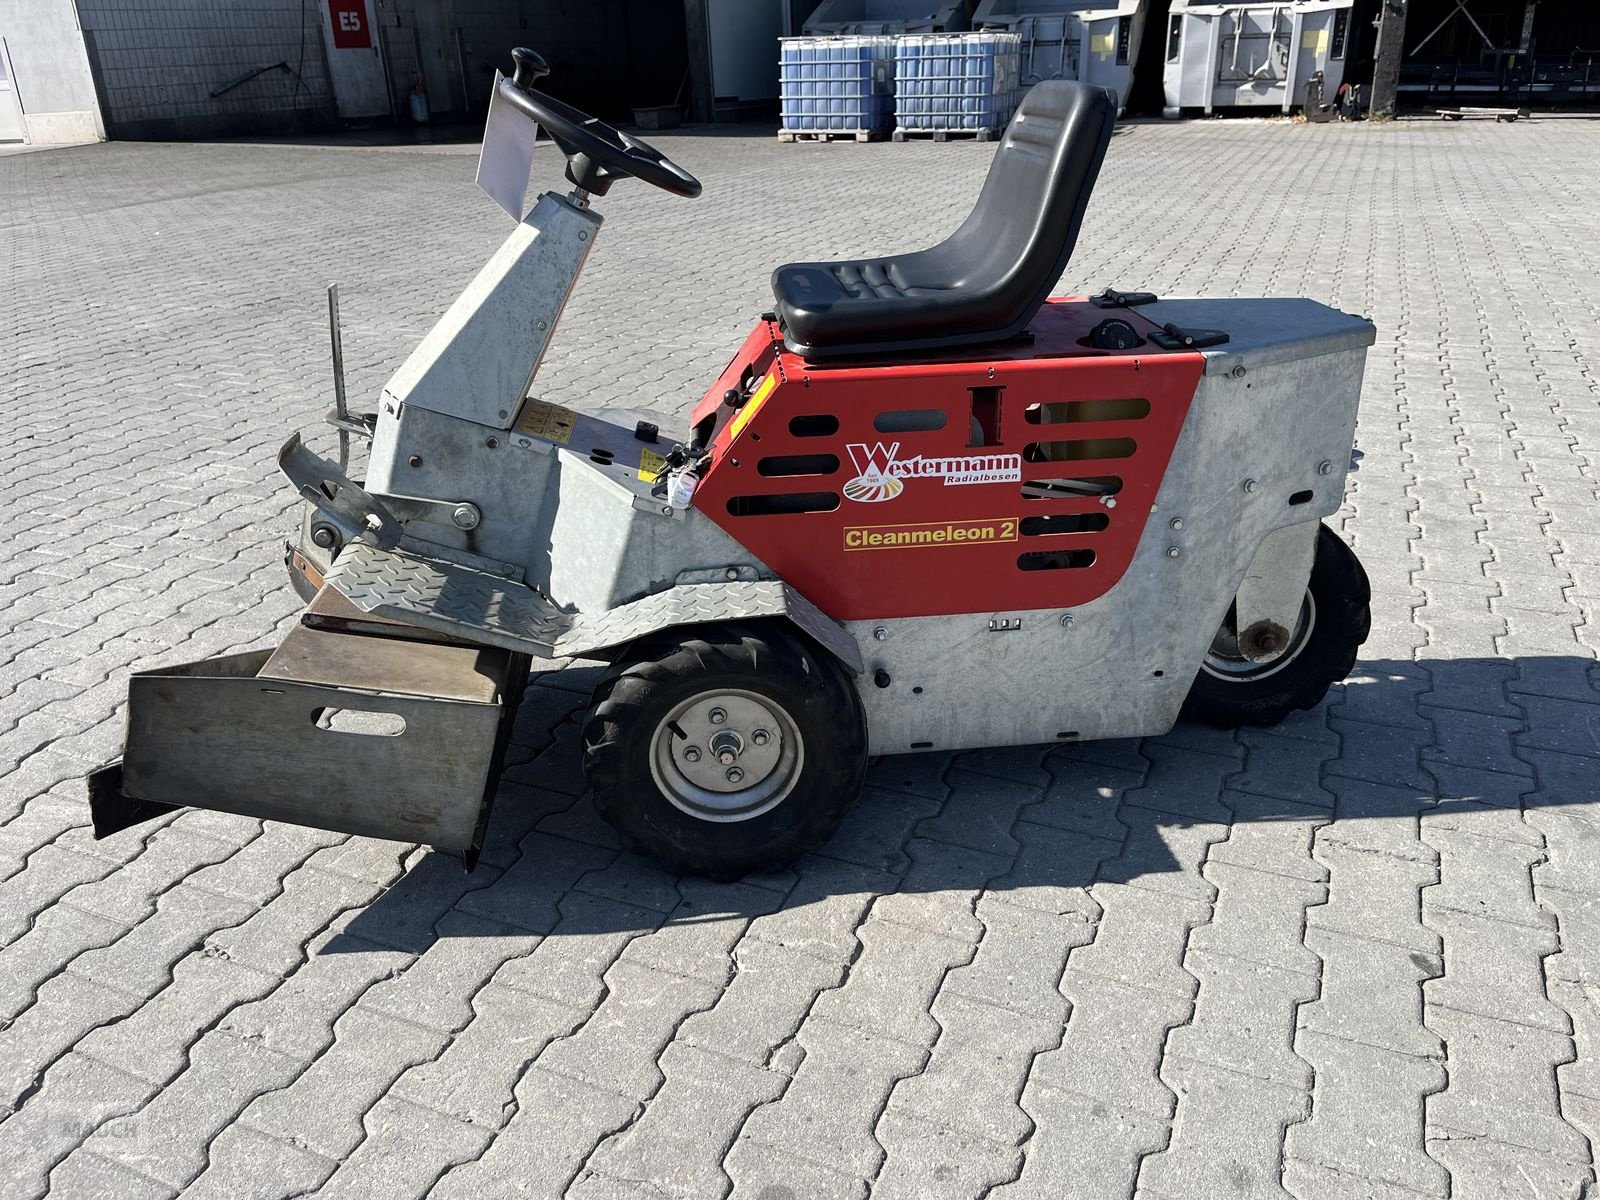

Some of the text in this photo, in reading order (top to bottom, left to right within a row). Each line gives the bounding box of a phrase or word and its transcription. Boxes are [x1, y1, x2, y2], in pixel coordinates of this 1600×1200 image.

[339, 11, 361, 31] E5
[846, 442, 1019, 477] Westermann
[947, 473, 1018, 483] Radialbesen
[846, 522, 1014, 546] Cleanmeleon 2
